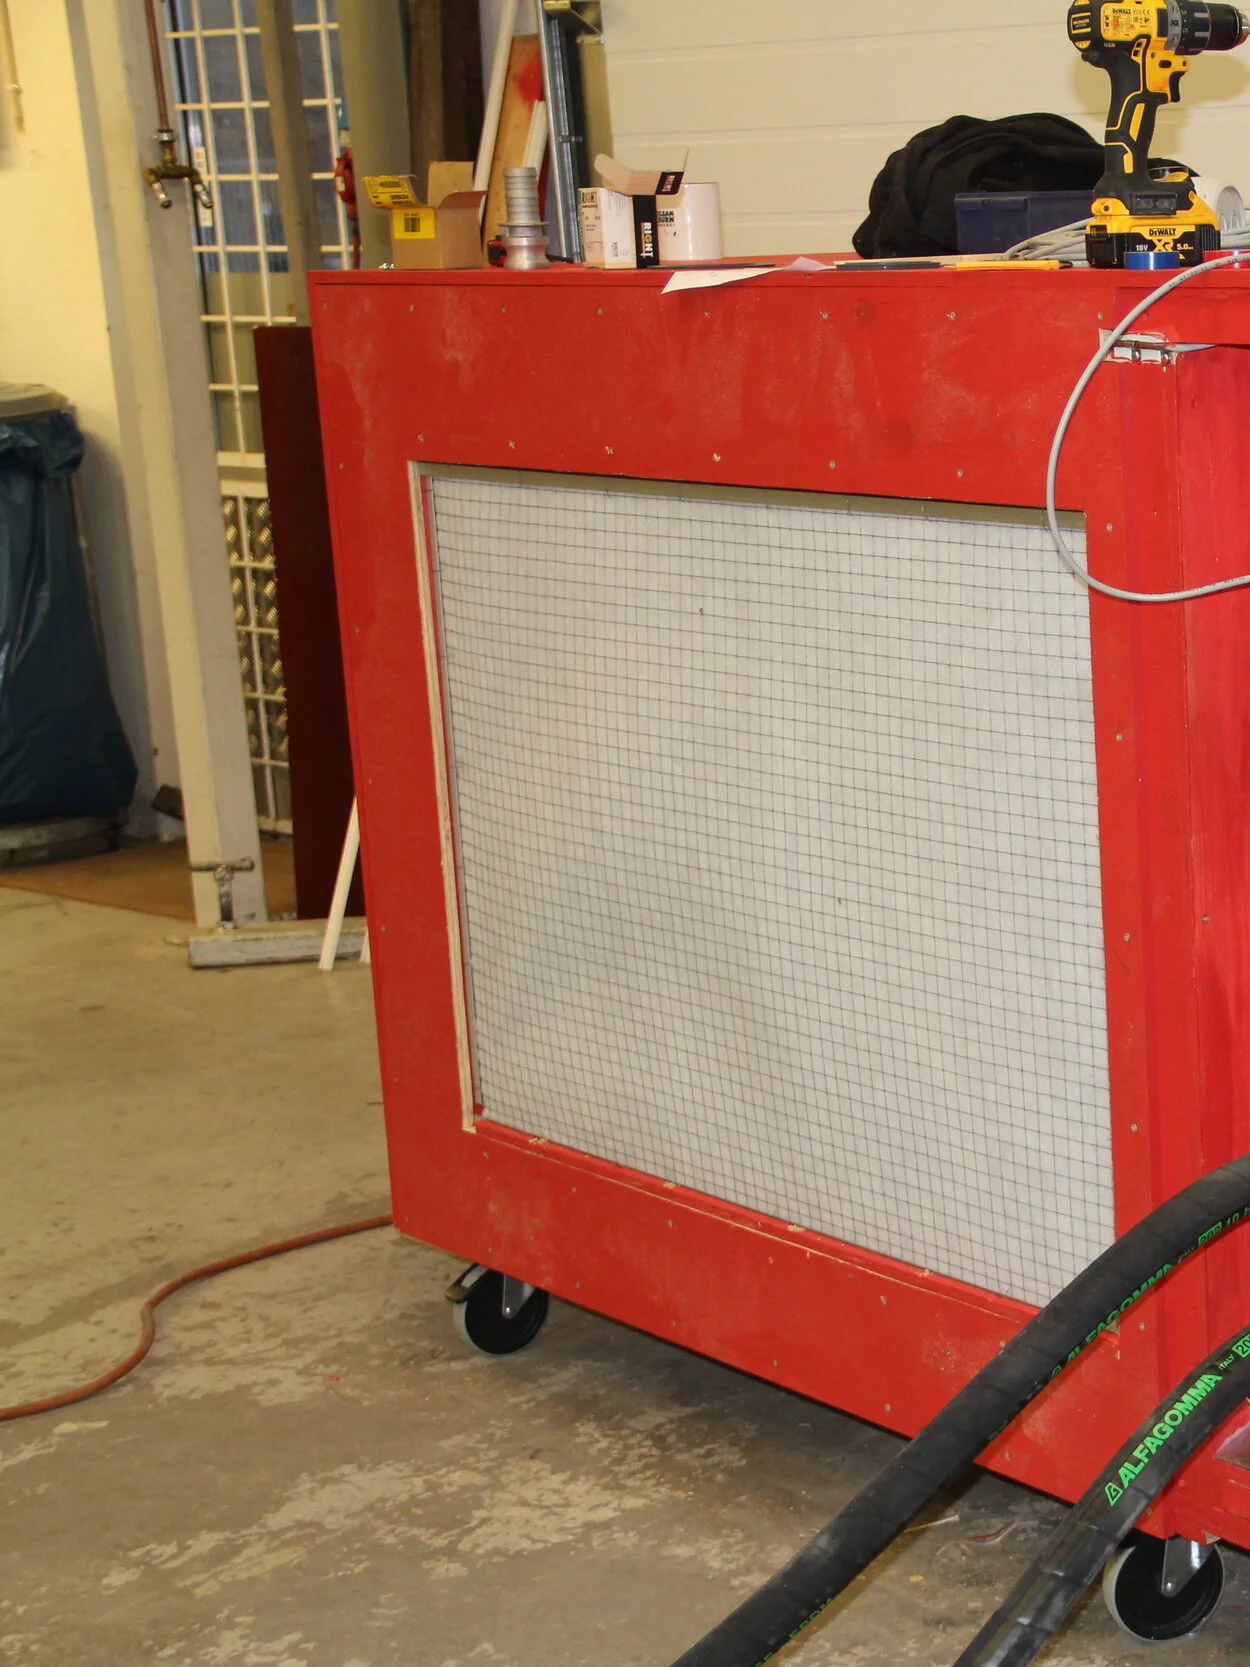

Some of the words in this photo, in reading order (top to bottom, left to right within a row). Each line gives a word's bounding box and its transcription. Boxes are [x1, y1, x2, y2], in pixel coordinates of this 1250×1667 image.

[640, 222, 654, 258] RIGHT
[1135, 244, 1149, 252] 18V
[1117, 1371, 1223, 1489] ALFAGOMMA
[1218, 1353, 1236, 1370] ITALY
